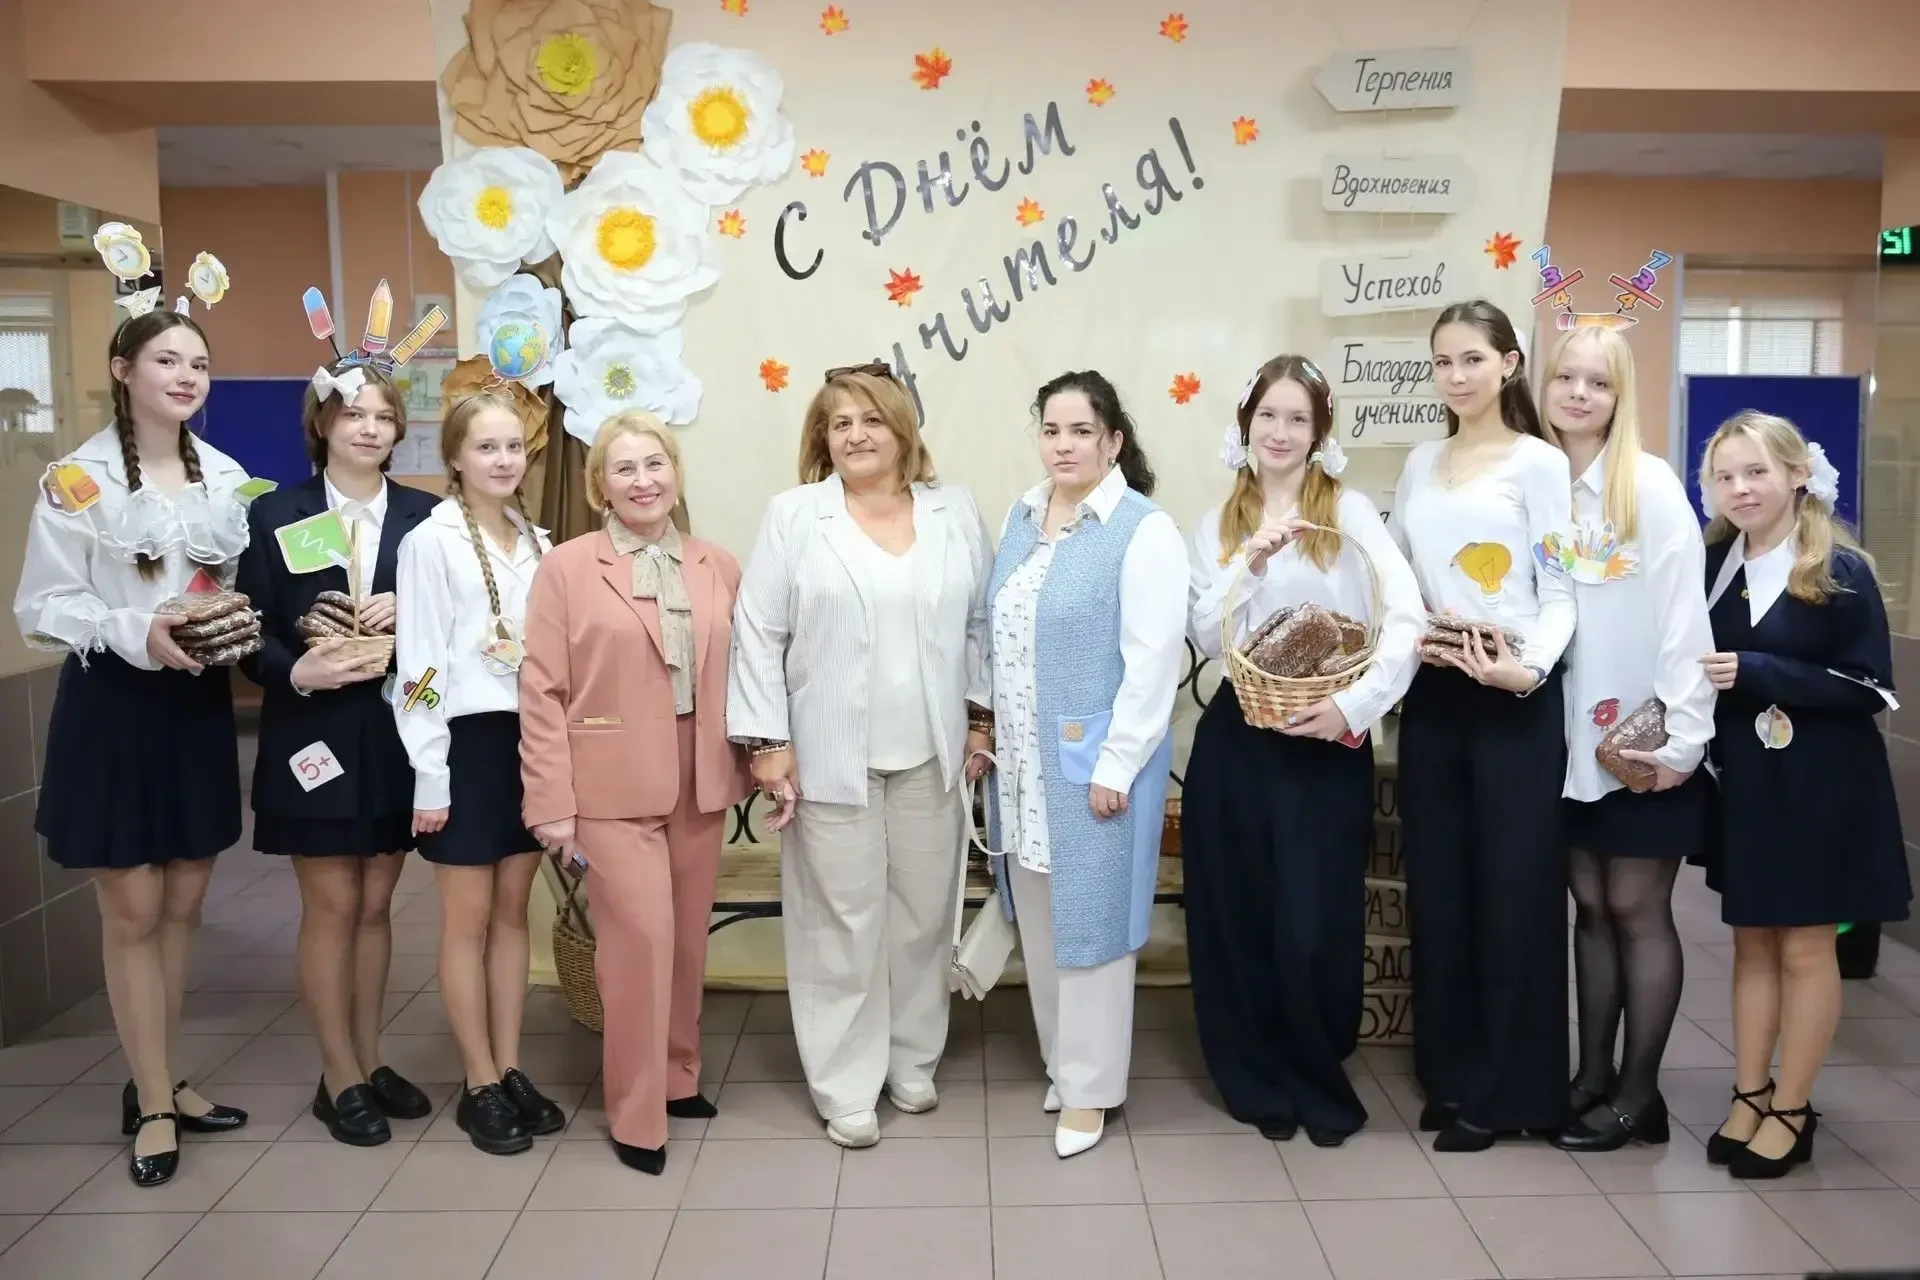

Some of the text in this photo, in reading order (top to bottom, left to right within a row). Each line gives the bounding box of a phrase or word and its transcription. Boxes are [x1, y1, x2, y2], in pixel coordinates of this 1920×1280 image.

[1354, 58, 1453, 105] Терпения
[774, 101, 1076, 280] С Днём
[1331, 164, 1451, 207] Вдохновения
[873, 117, 1204, 428] учителя!
[1341, 262, 1445, 303] Успехов
[1342, 343, 1435, 394] Благодар
[1352, 403, 1446, 438] учеников
[297, 756, 331, 781] 5+
